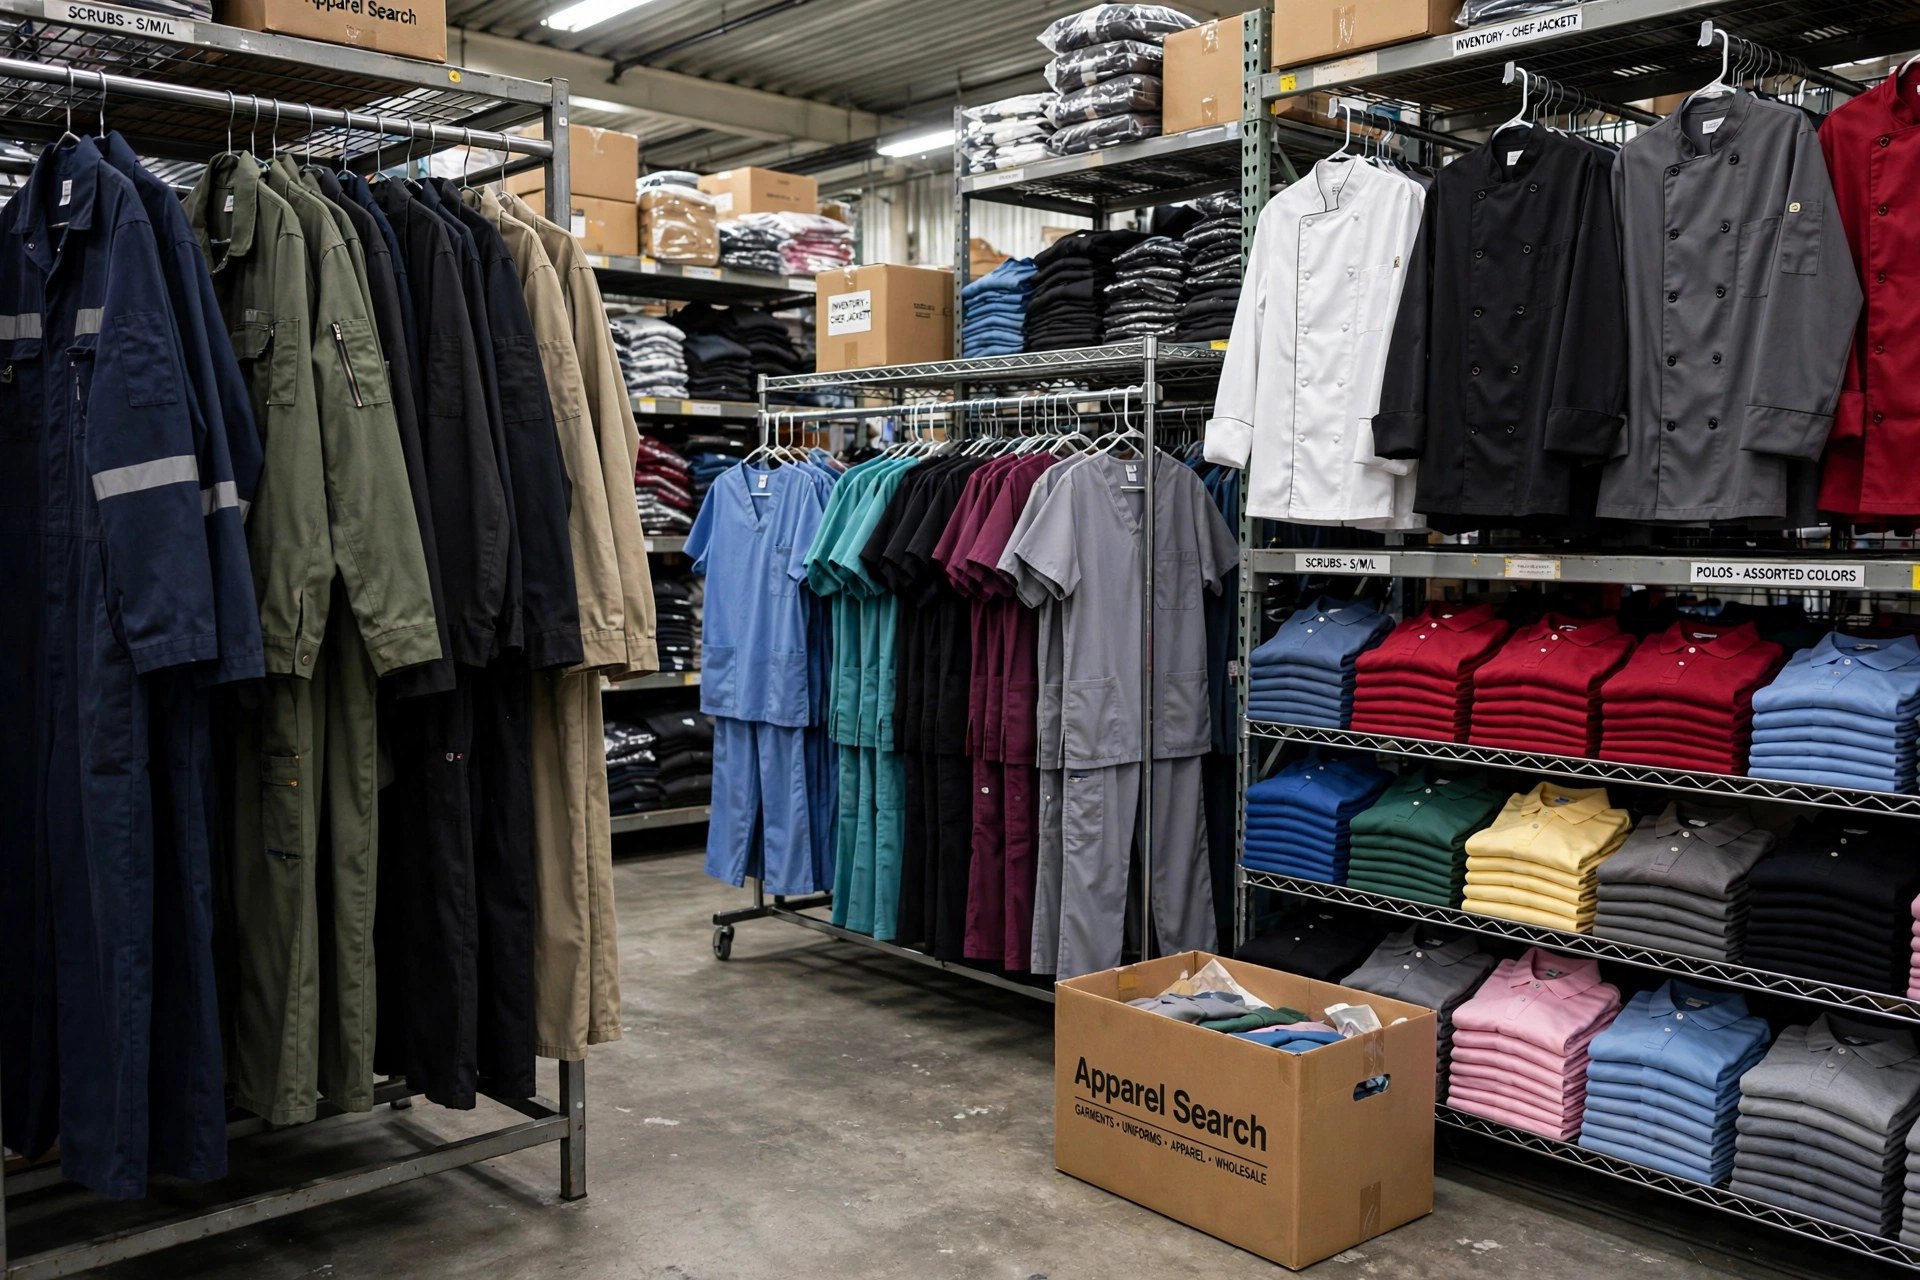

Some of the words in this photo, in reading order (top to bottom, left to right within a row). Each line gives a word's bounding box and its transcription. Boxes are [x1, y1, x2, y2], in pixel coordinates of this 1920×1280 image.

[68, 6, 124, 26] SCRUBS
[136, 17, 175, 35] S/M/L
[304, 0, 363, 14] pparel
[368, 0, 417, 25] Search
[1456, 30, 1504, 50] INVENTORY
[1512, 23, 1535, 38] CHEF
[1305, 557, 1342, 568] SCRUBS
[1350, 558, 1376, 571] S/M/L
[1696, 566, 1733, 578] POLOS
[1743, 568, 1804, 580] ASSORTED
[1807, 570, 1856, 581] COLORS
[1074, 1056, 1165, 1116] Apparel
[1173, 1089, 1267, 1151] Search
[1075, 1103, 1115, 1128] GARMENTS
[1121, 1121, 1162, 1146] UNIFORMS
[1170, 1140, 1206, 1163] APPAREL
[1215, 1156, 1267, 1185] WHOLESALE
